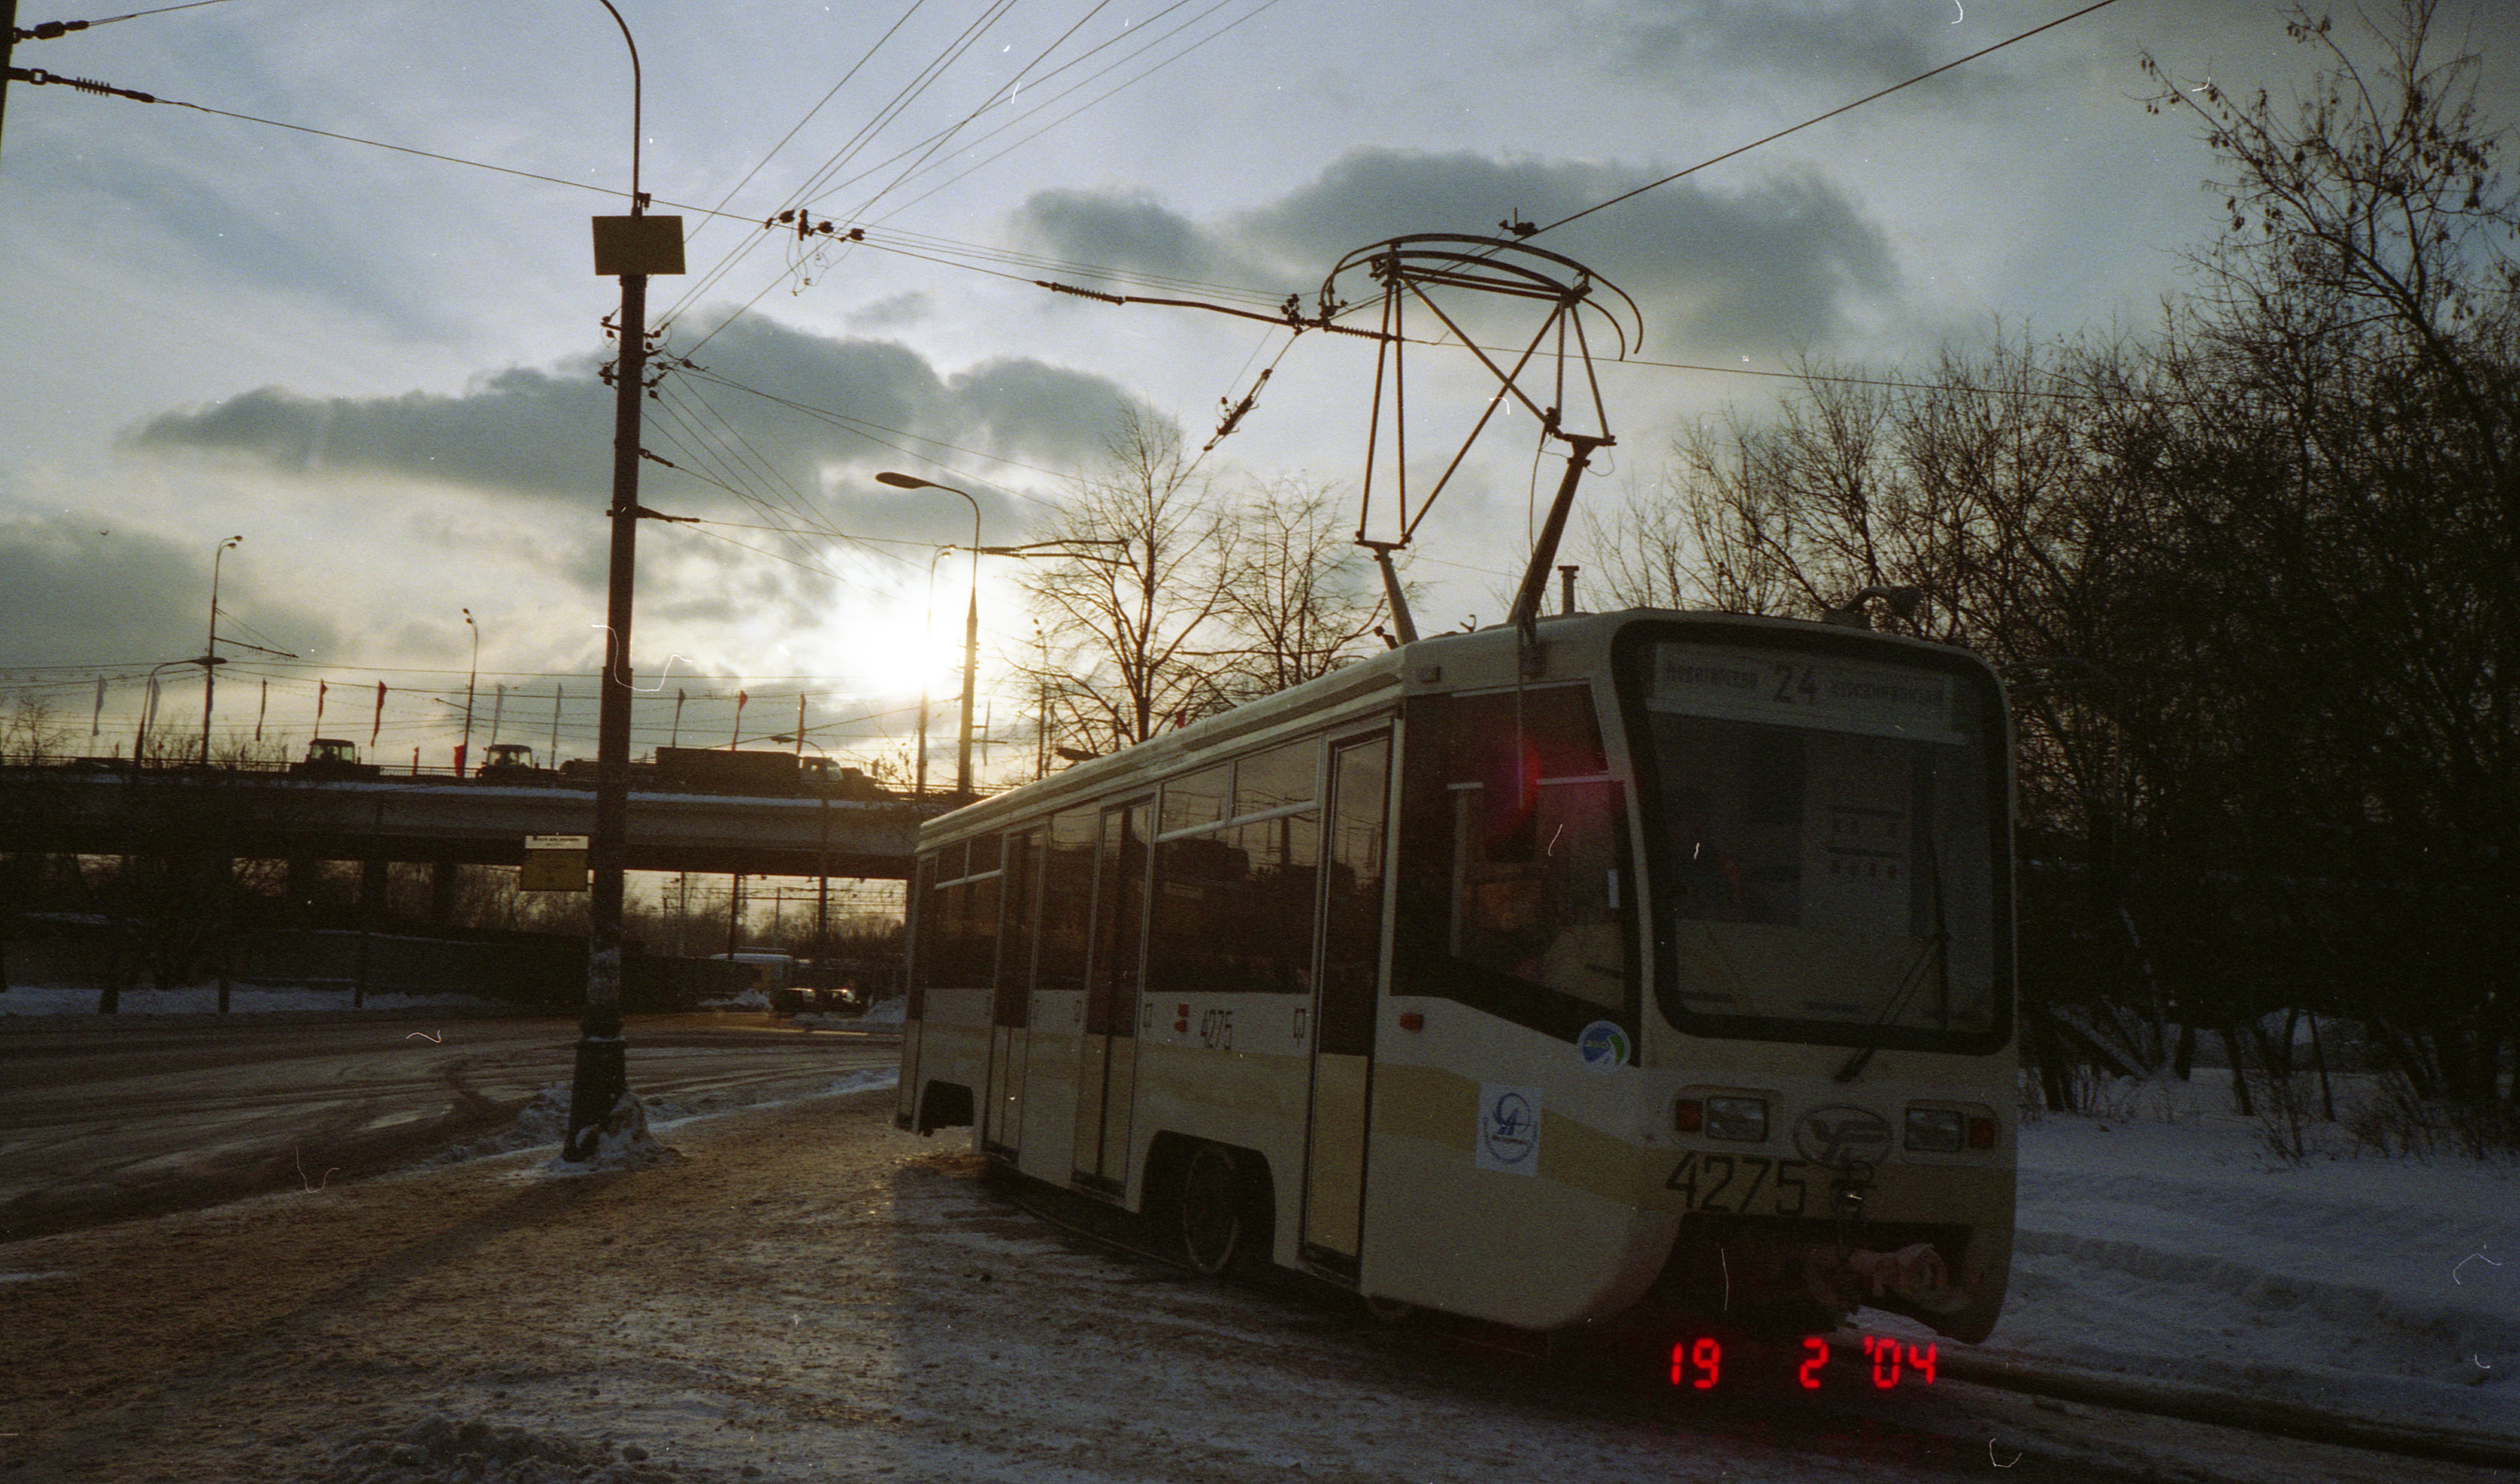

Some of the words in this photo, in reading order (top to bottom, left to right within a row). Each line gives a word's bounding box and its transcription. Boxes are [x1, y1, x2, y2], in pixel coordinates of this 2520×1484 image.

[1773, 663, 1818, 705] 24
[1200, 1009, 1233, 1050] 4275
[1666, 1150, 1807, 1215] 4275
